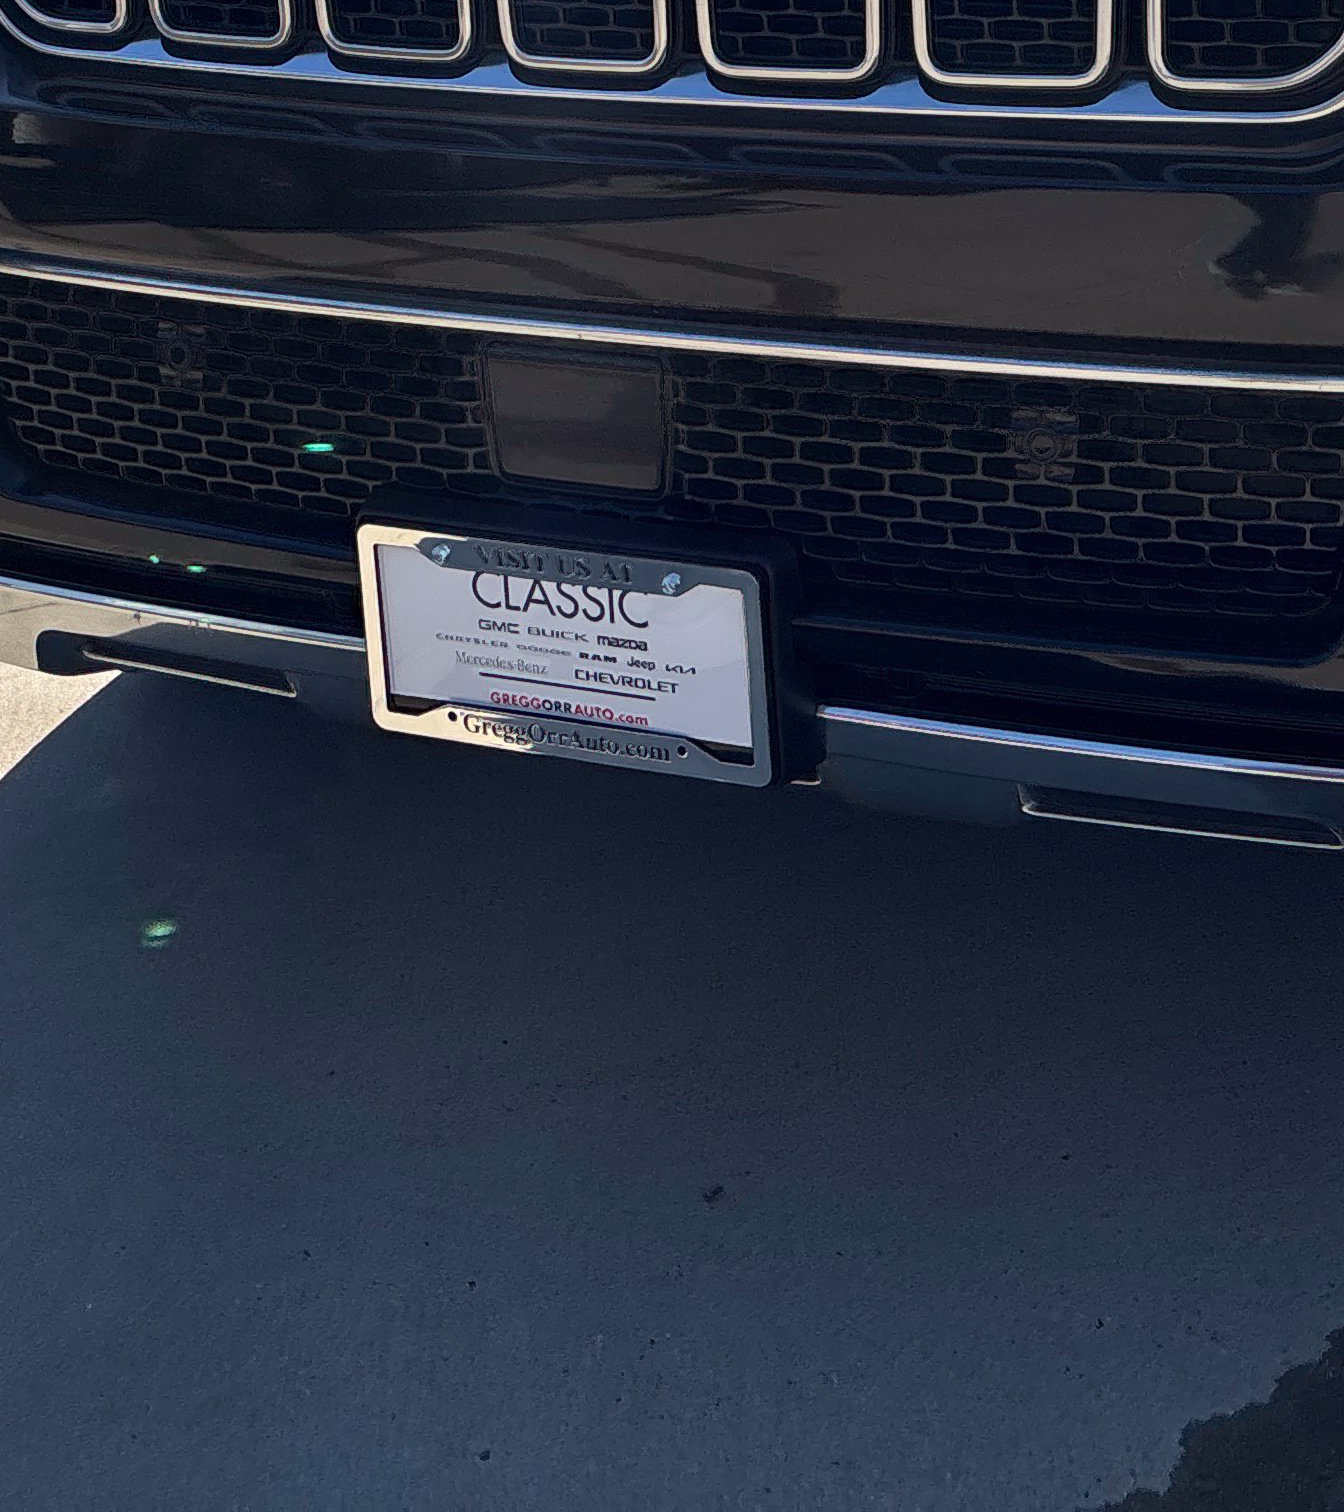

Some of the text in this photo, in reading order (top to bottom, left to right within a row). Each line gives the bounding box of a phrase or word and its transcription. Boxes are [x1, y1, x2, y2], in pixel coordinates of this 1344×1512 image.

[473, 544, 634, 586] VISIT US AT
[472, 570, 649, 628] CLASSIC
[478, 618, 649, 652] GMC BUICK mazda
[578, 651, 618, 664] RAM
[626, 656, 657, 672] Jeep
[574, 668, 680, 694] CHEVROLET
[489, 691, 650, 728] GREGGORRAUTO.com
[463, 713, 672, 764] GreggOrrAuto.com
